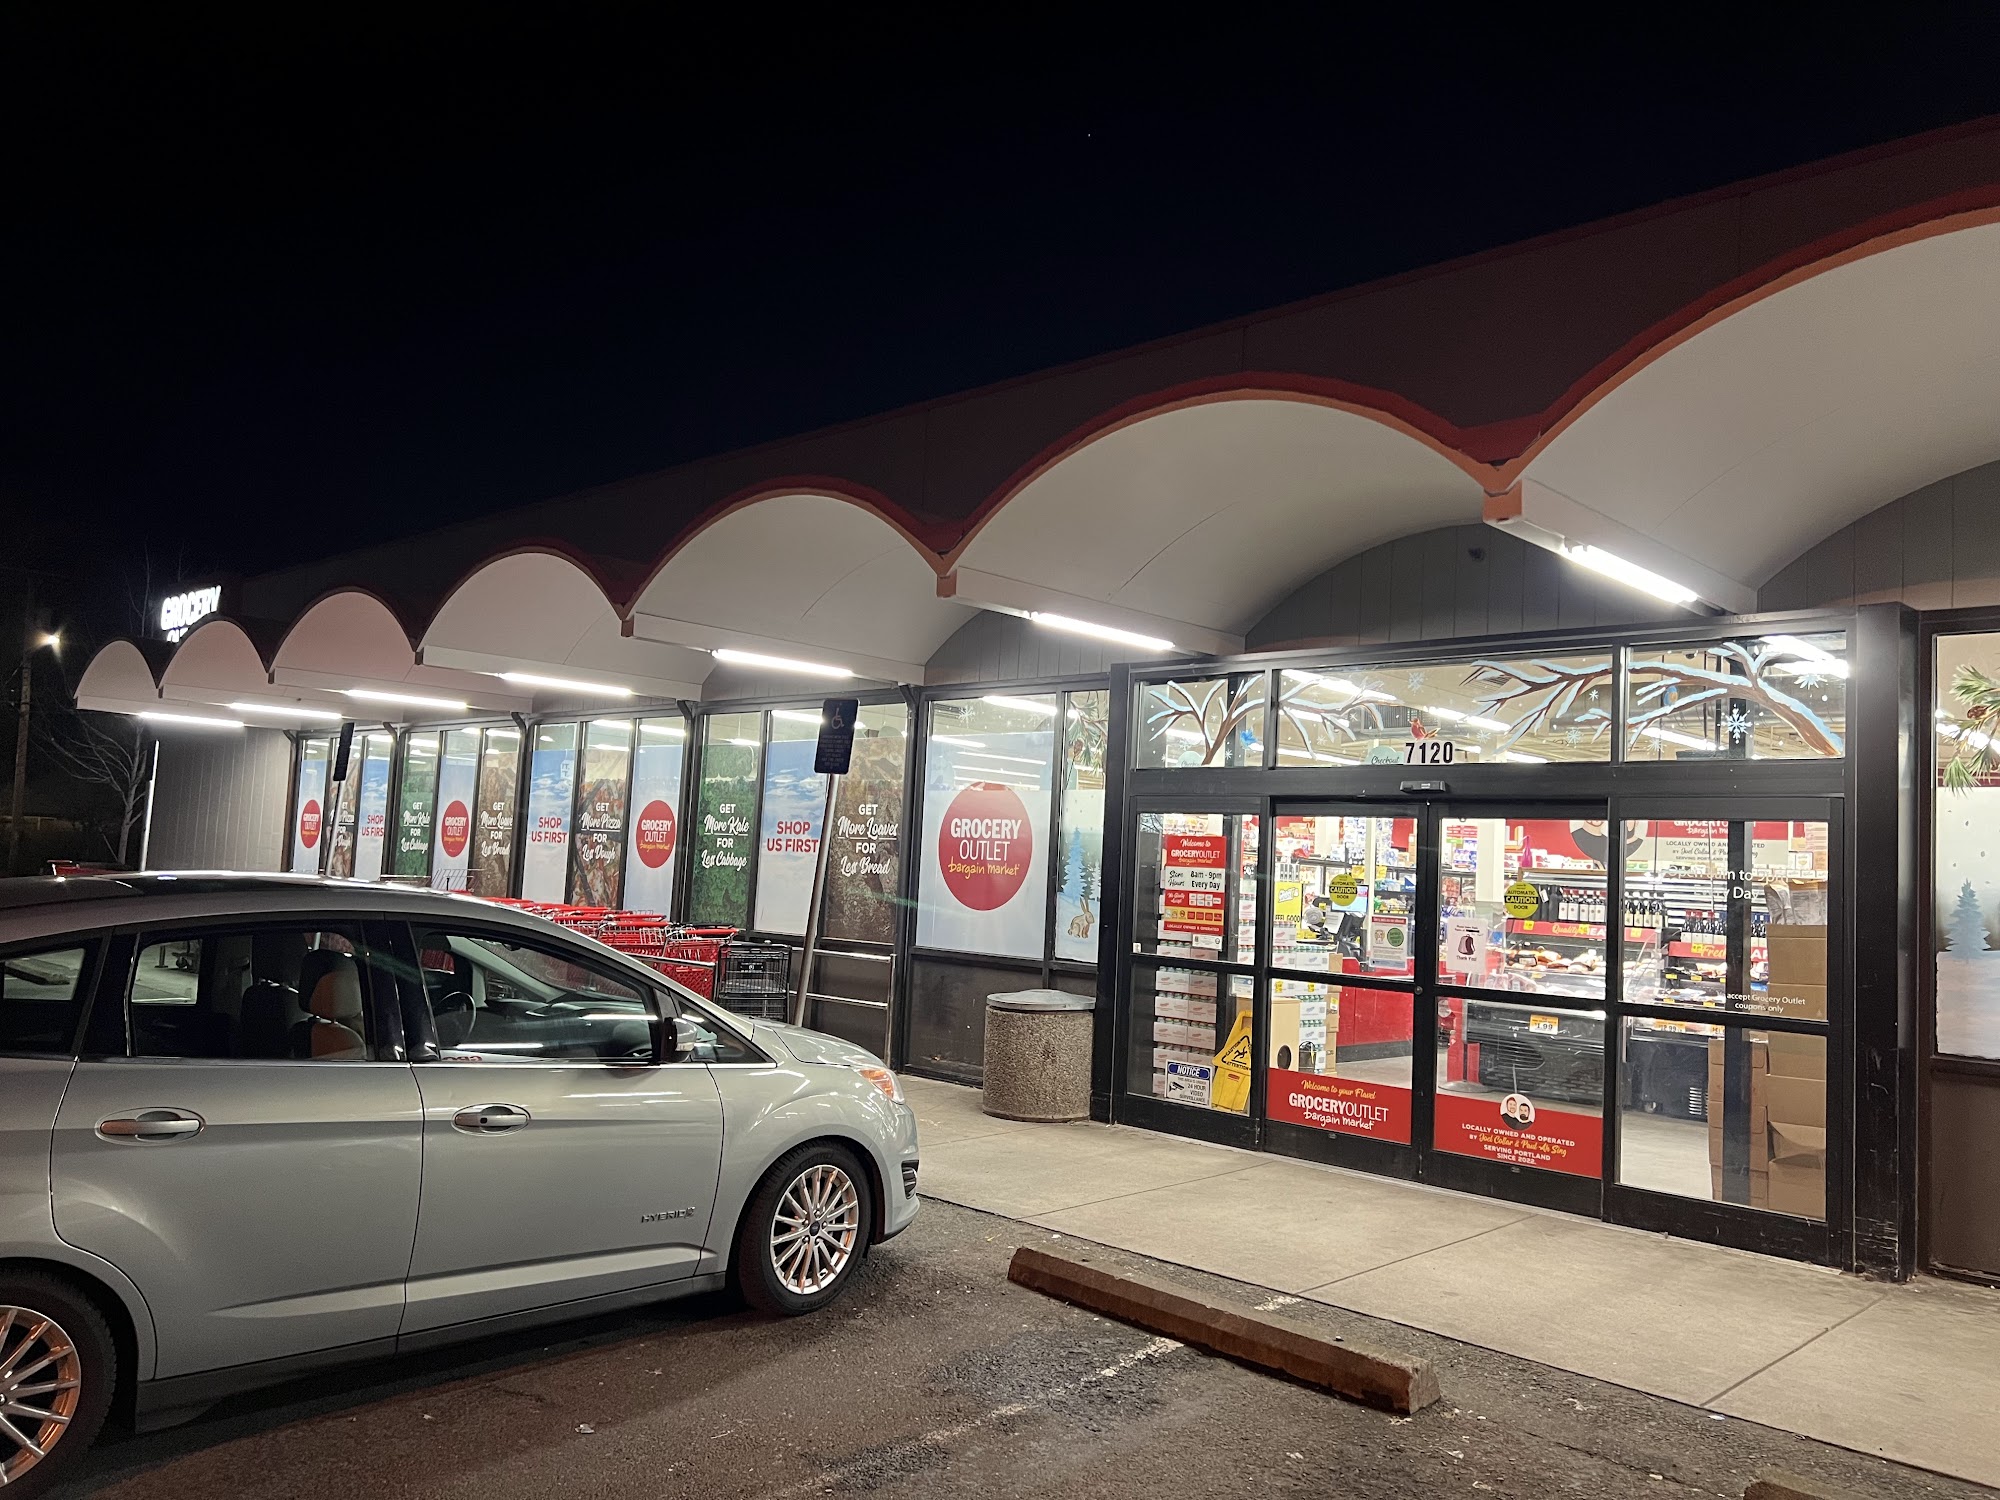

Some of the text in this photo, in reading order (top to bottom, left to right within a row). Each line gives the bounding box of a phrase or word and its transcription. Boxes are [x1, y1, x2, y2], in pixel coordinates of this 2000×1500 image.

[161, 585, 221, 631] GROCERY
[1405, 741, 1453, 764] 7120
[412, 802, 423, 811] GET
[492, 802, 505, 811] GET
[595, 802, 609, 812] GET
[719, 803, 737, 814] GET
[858, 803, 878, 816] GET
[367, 814, 385, 825] SHOP
[444, 816, 467, 826] GROCERY
[538, 816, 562, 829] SHOP
[580, 812, 622, 829] More Pizza
[640, 818, 673, 832] GROCERY
[703, 814, 750, 835] More Kale
[361, 826, 385, 837] US FIRS
[410, 828, 421, 837] FOR
[446, 826, 463, 836] OUTLET
[776, 820, 811, 835] SHOP
[837, 815, 899, 841] More Loaves
[950, 817, 1022, 840] GROCERY
[490, 830, 503, 840] FOR
[531, 831, 568, 844] US FIRST
[592, 832, 608, 843] FOR
[644, 831, 667, 843] OUTLET
[716, 837, 734, 848] FOR
[766, 838, 819, 853] US FIRST
[855, 841, 877, 854] FOR
[1180, 838, 1211, 848] Welcome to
[1666, 840, 1692, 848] LOCALLY
[1693, 841, 1716, 849] OWND
[595, 844, 616, 862] Dough
[959, 839, 1011, 861] OUTLET
[701, 848, 747, 872] Less Cabbage
[840, 855, 891, 878] Less Bread
[947, 855, 1021, 880] bargain market
[1208, 871, 1222, 880] 9pm
[1738, 870, 1754, 881] to
[1191, 880, 1221, 891] Every Day
[1329, 886, 1357, 894] CAUTION
[1505, 896, 1537, 904] CAUTION
[1733, 886, 1760, 901] Day
[1726, 993, 1806, 1006] accept Grocery Outlet
[1734, 1002, 1784, 1014] coupons only
[1225, 1040, 1241, 1056] CAUTION
[1176, 1064, 1200, 1077] NOTICE
[1226, 1061, 1249, 1071] ATTENTION
[1189, 1089, 1204, 1098] VIDEO
[1193, 1084, 1207, 1092] HOUR
[1300, 1079, 1330, 1093] Welcome
[1330, 1085, 1338, 1094] to
[1338, 1088, 1354, 1097] your
[1303, 1108, 1376, 1130] bargain market
[1461, 1123, 1576, 1147] LOCALLY OWNED AND OPERATED
[1478, 1133, 1493, 1143] Joel
[1493, 1136, 1514, 1146] Collar
[1520, 1139, 1537, 1150] Paul
[1550, 1144, 1567, 1158] Sing
[1483, 1144, 1551, 1161] SERVING PORTLAND
[1496, 1153, 1537, 1165] SINCE 2022.
[641, 1208, 686, 1223] HYBRID
